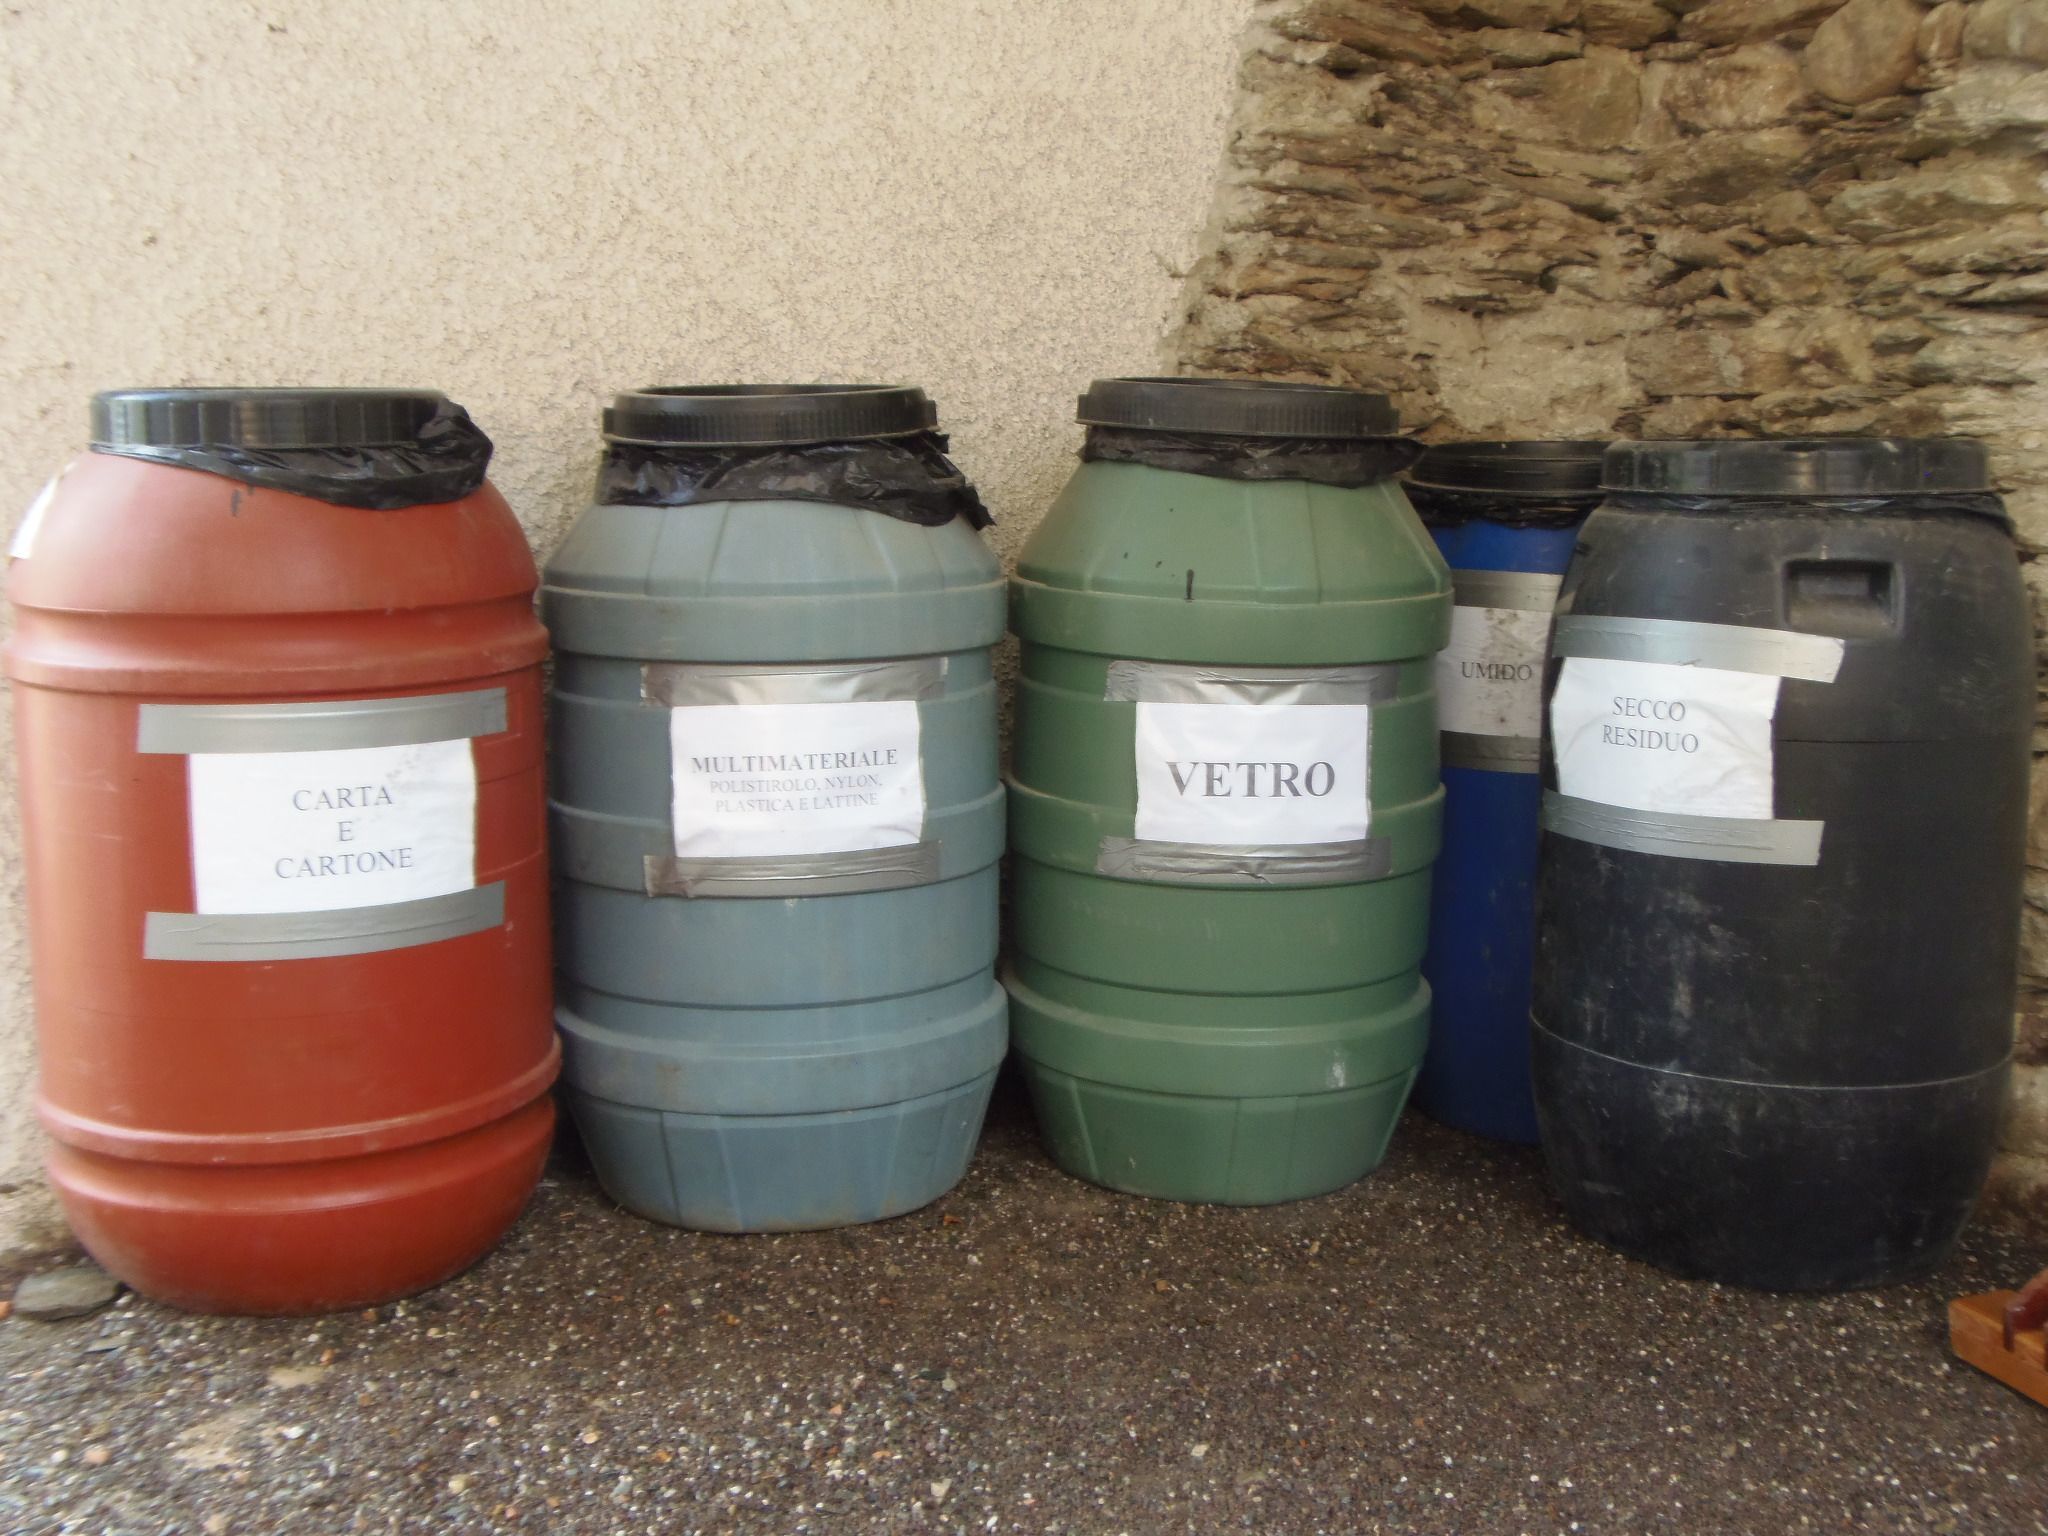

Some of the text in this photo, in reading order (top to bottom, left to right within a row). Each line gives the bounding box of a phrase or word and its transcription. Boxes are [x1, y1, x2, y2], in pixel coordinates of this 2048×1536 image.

[1461, 661, 1532, 680] UMIDO
[1612, 696, 1686, 722] SECCO
[1602, 724, 1699, 753] RESIDUO
[692, 749, 897, 774] MULTIMATERIALE
[1166, 761, 1335, 798] VETRO
[292, 785, 393, 811] CARTA
[715, 792, 880, 813] PLASTICA E LATTINE
[337, 820, 354, 842] E
[274, 847, 413, 879] CARTONE
